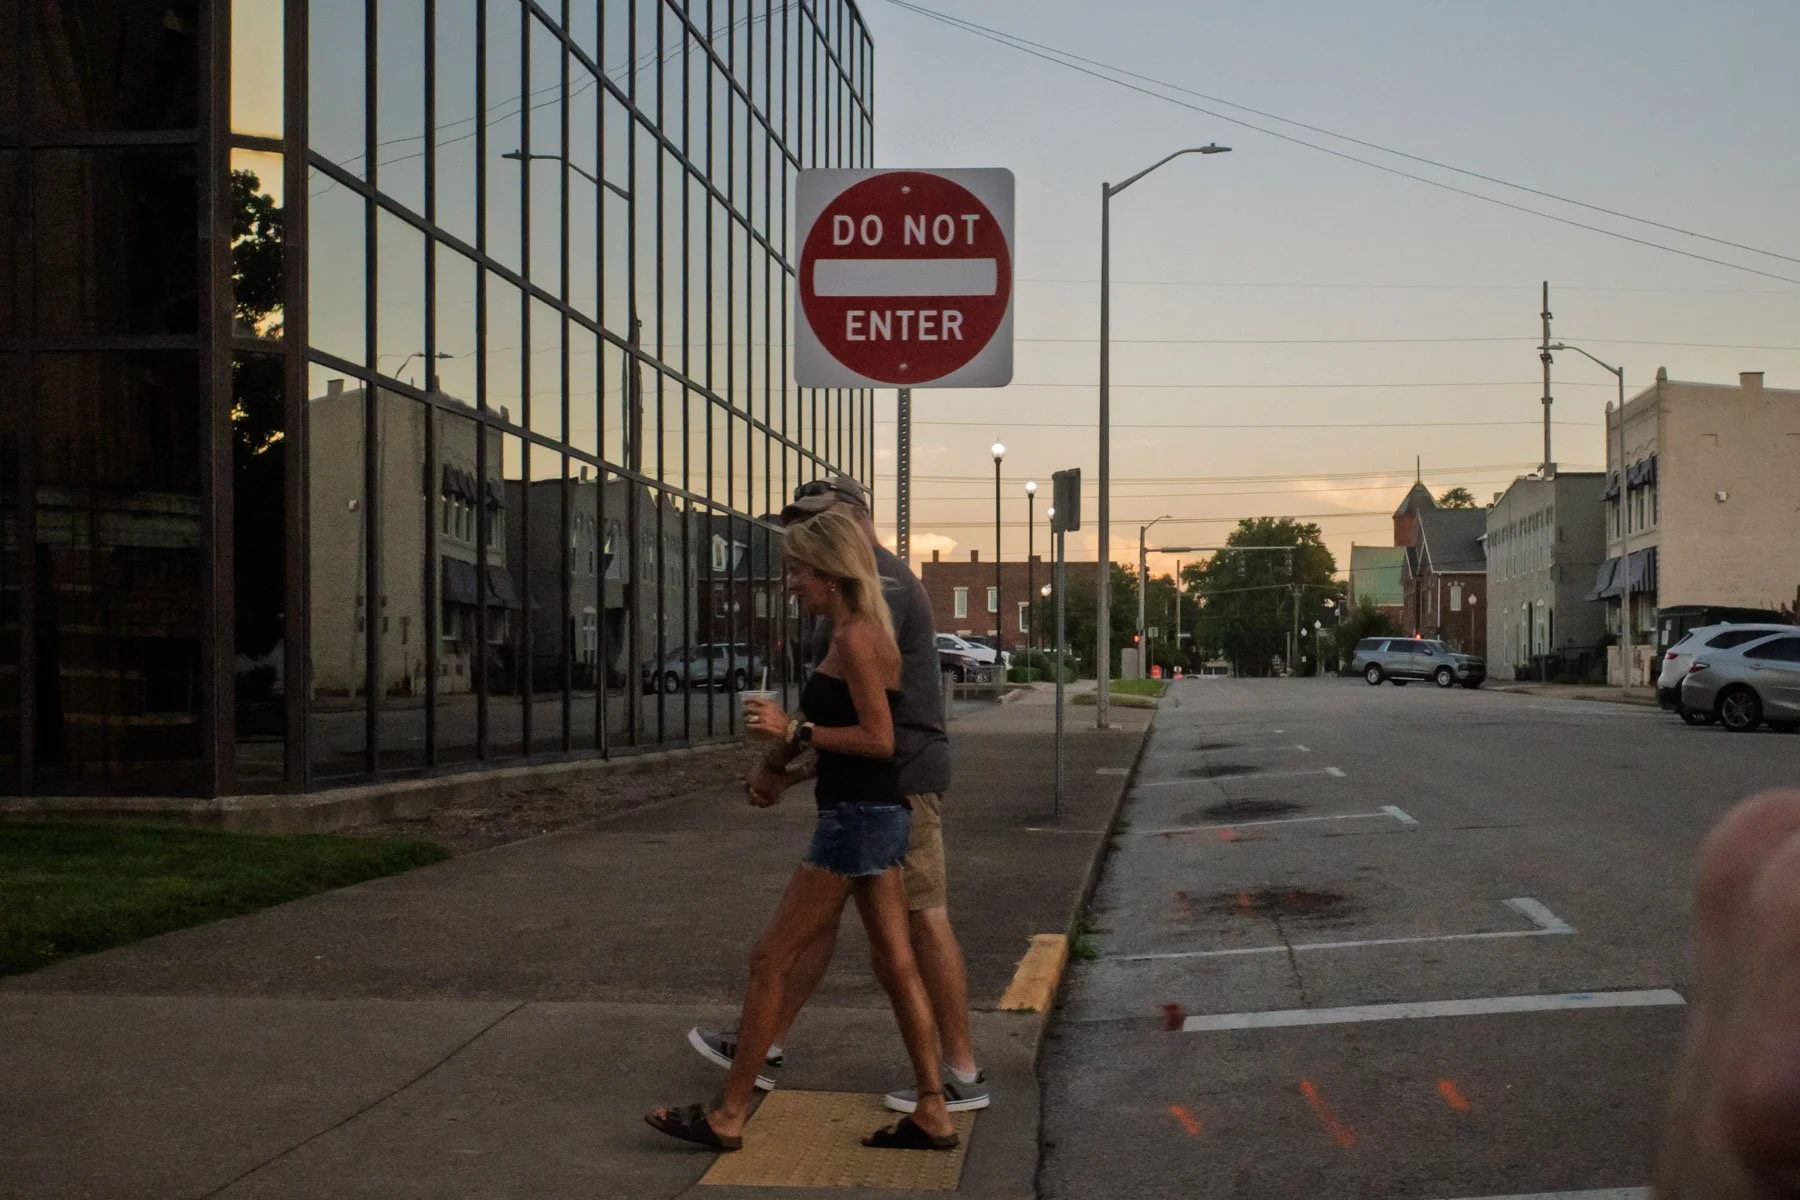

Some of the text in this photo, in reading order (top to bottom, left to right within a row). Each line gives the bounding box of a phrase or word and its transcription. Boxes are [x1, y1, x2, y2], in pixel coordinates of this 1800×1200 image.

[832, 214, 981, 246] DO NOT
[845, 310, 964, 341] ENTER
